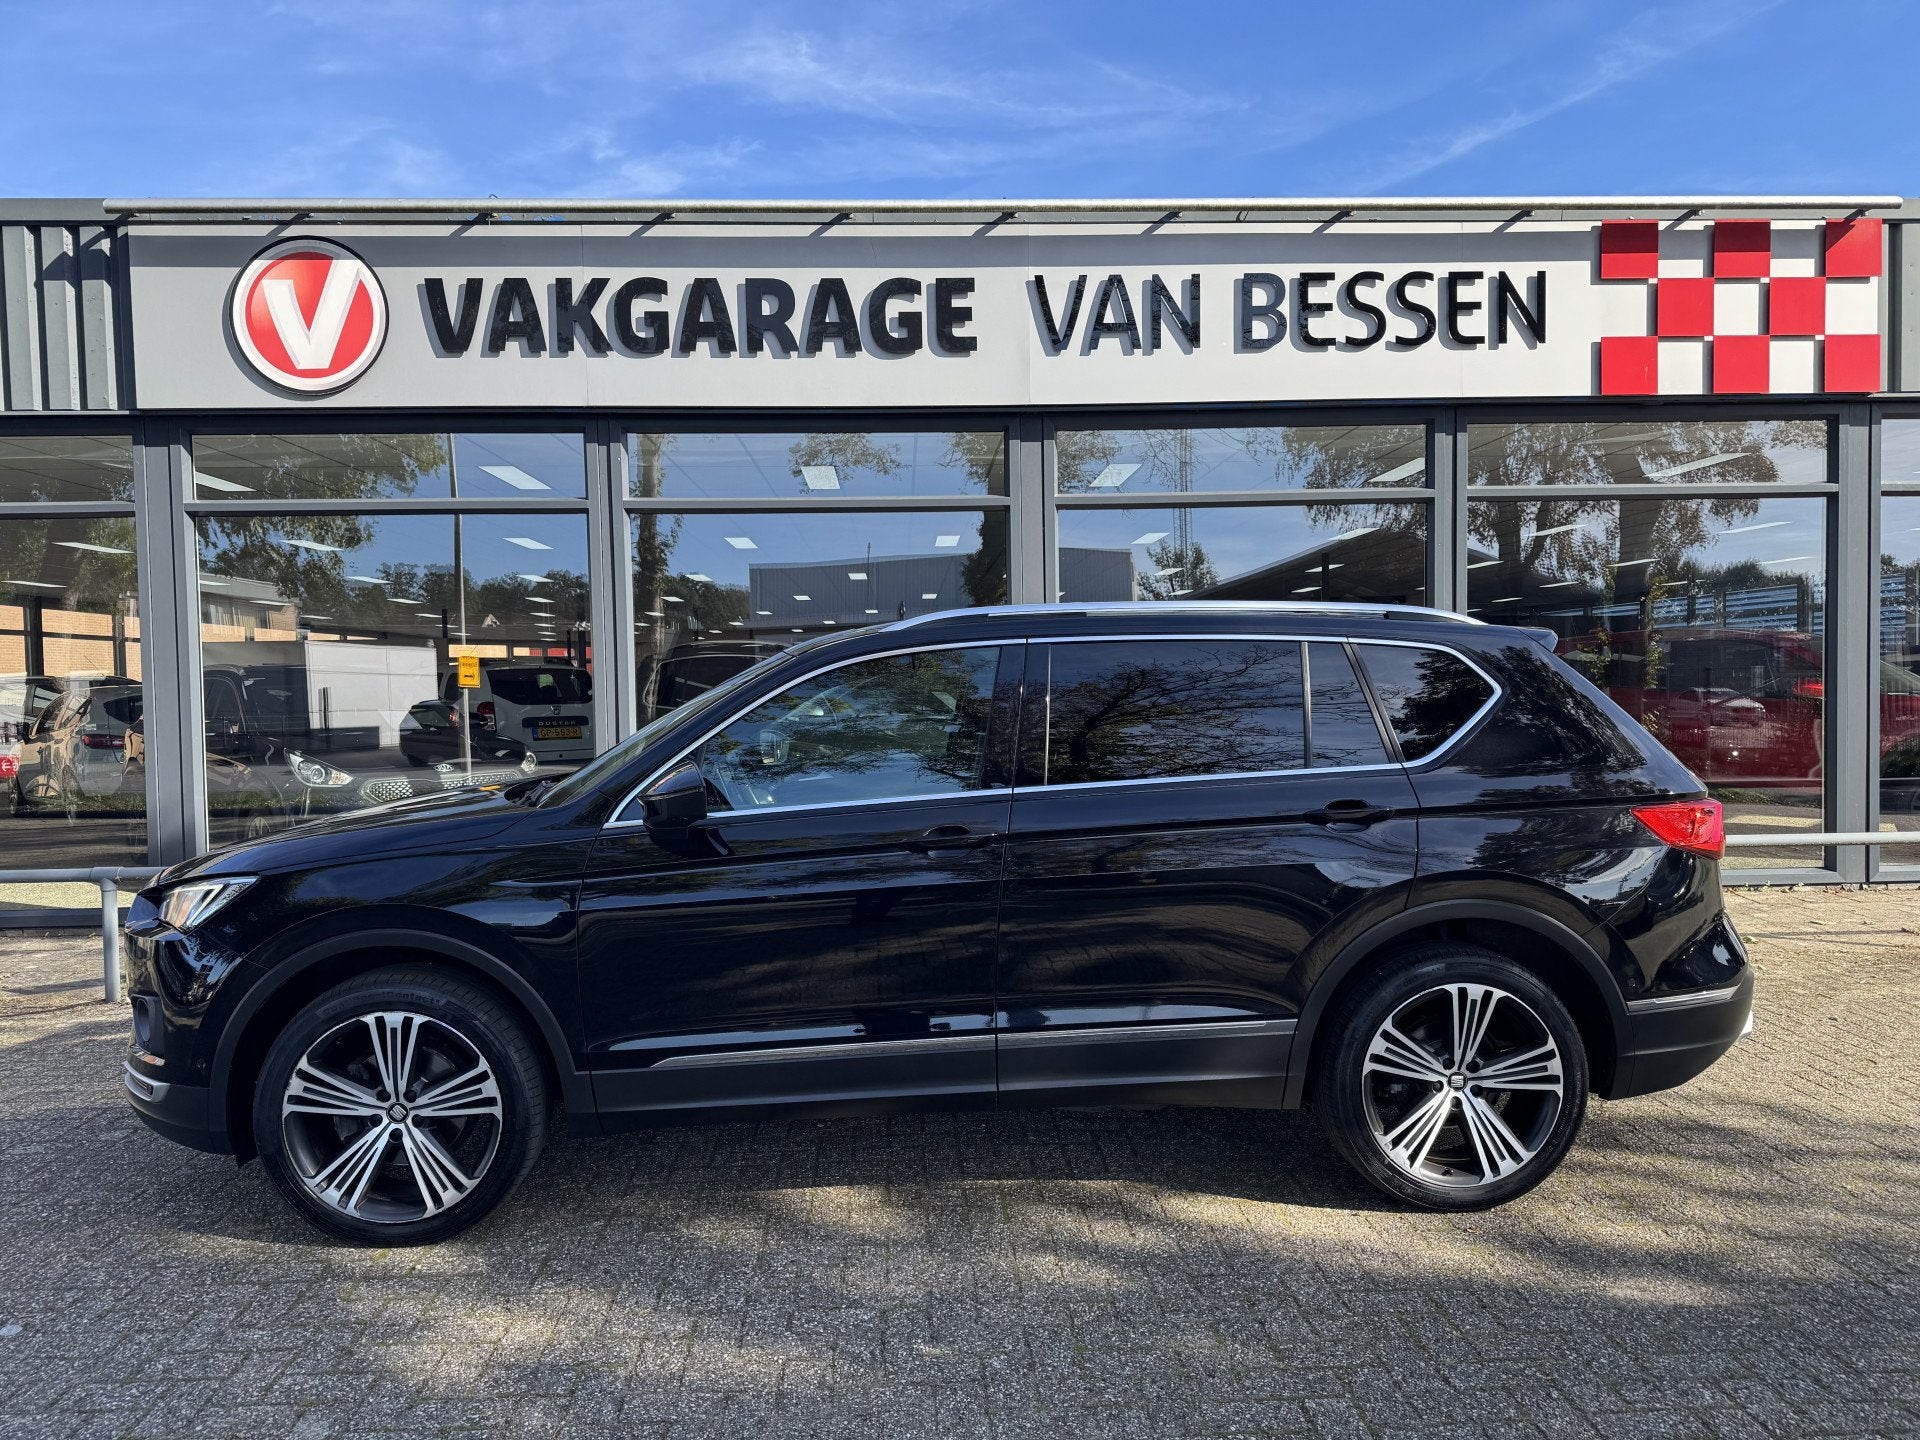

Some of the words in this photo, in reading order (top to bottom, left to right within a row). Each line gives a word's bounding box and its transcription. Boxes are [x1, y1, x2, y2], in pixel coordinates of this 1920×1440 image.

[259, 252, 365, 371] V
[423, 276, 978, 355] VAKGARAGE
[1033, 272, 1201, 352] VAN
[1241, 270, 1547, 350] BESSEN
